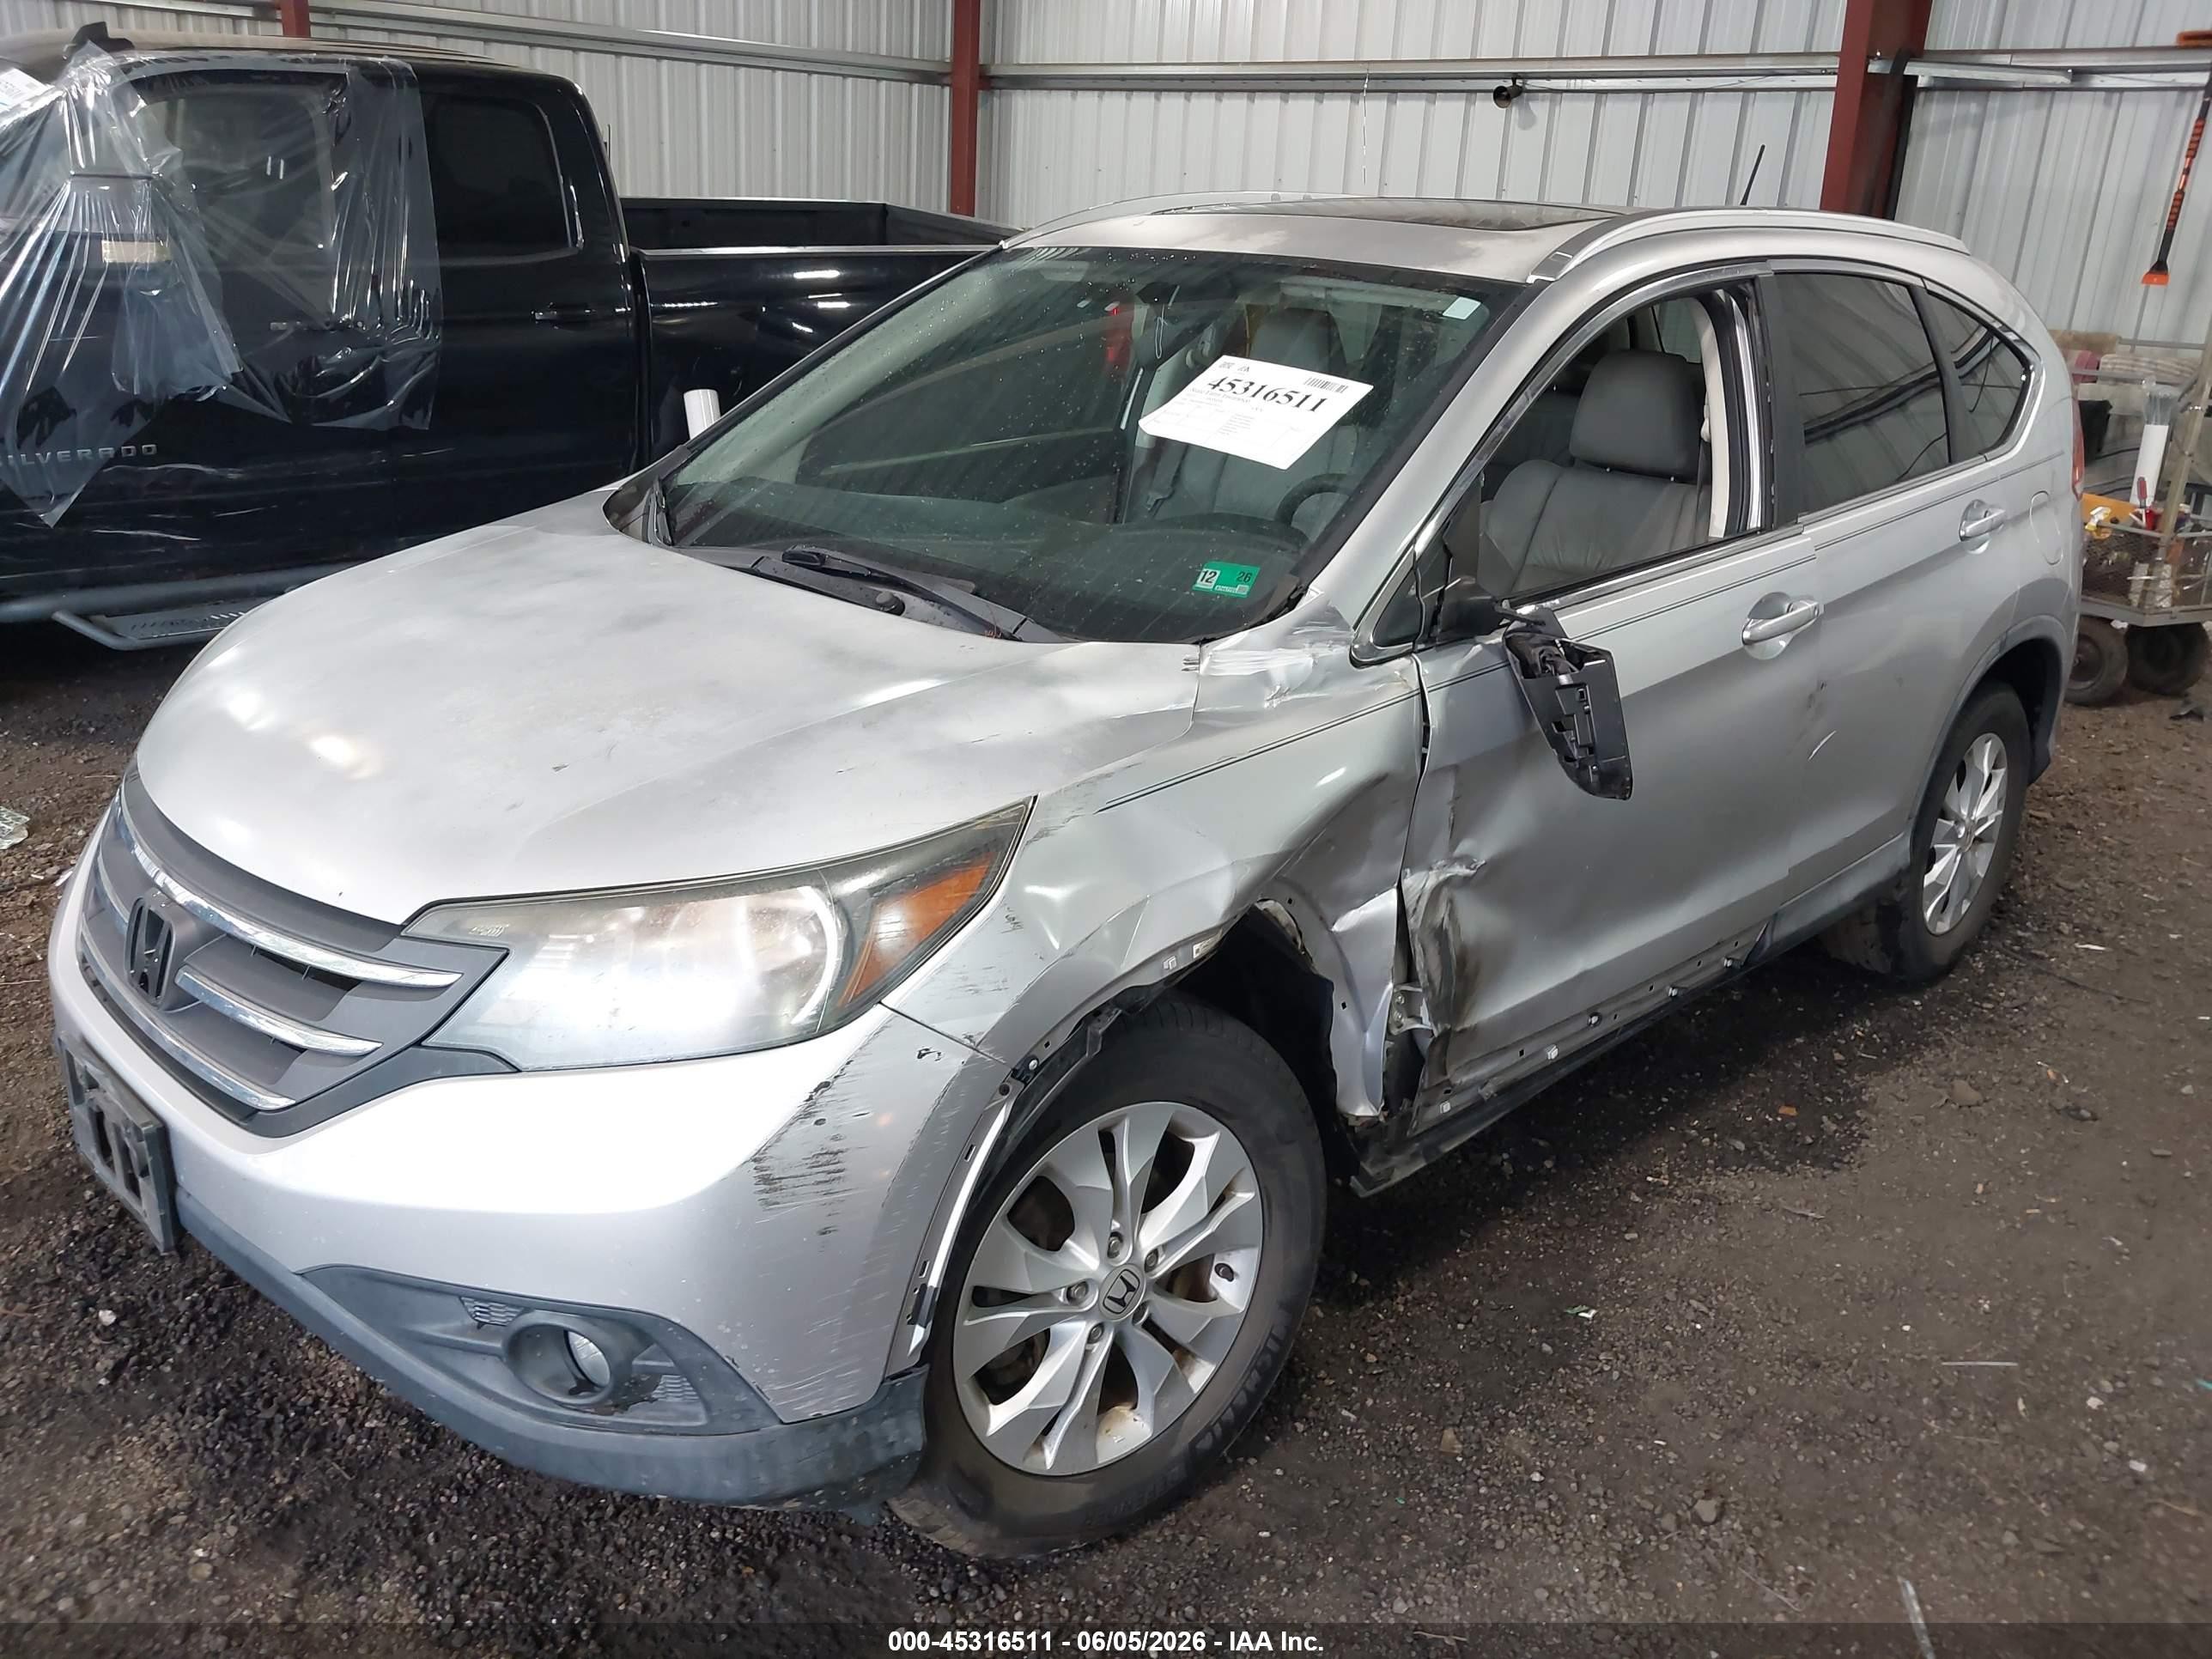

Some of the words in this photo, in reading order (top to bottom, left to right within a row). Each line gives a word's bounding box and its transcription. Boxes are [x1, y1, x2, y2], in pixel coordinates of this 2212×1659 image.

[1207, 376, 1328, 412] 45316511
[0, 443, 157, 466] ILVERADO
[1200, 569, 1218, 584] 12
[1237, 571, 1253, 583] 26
